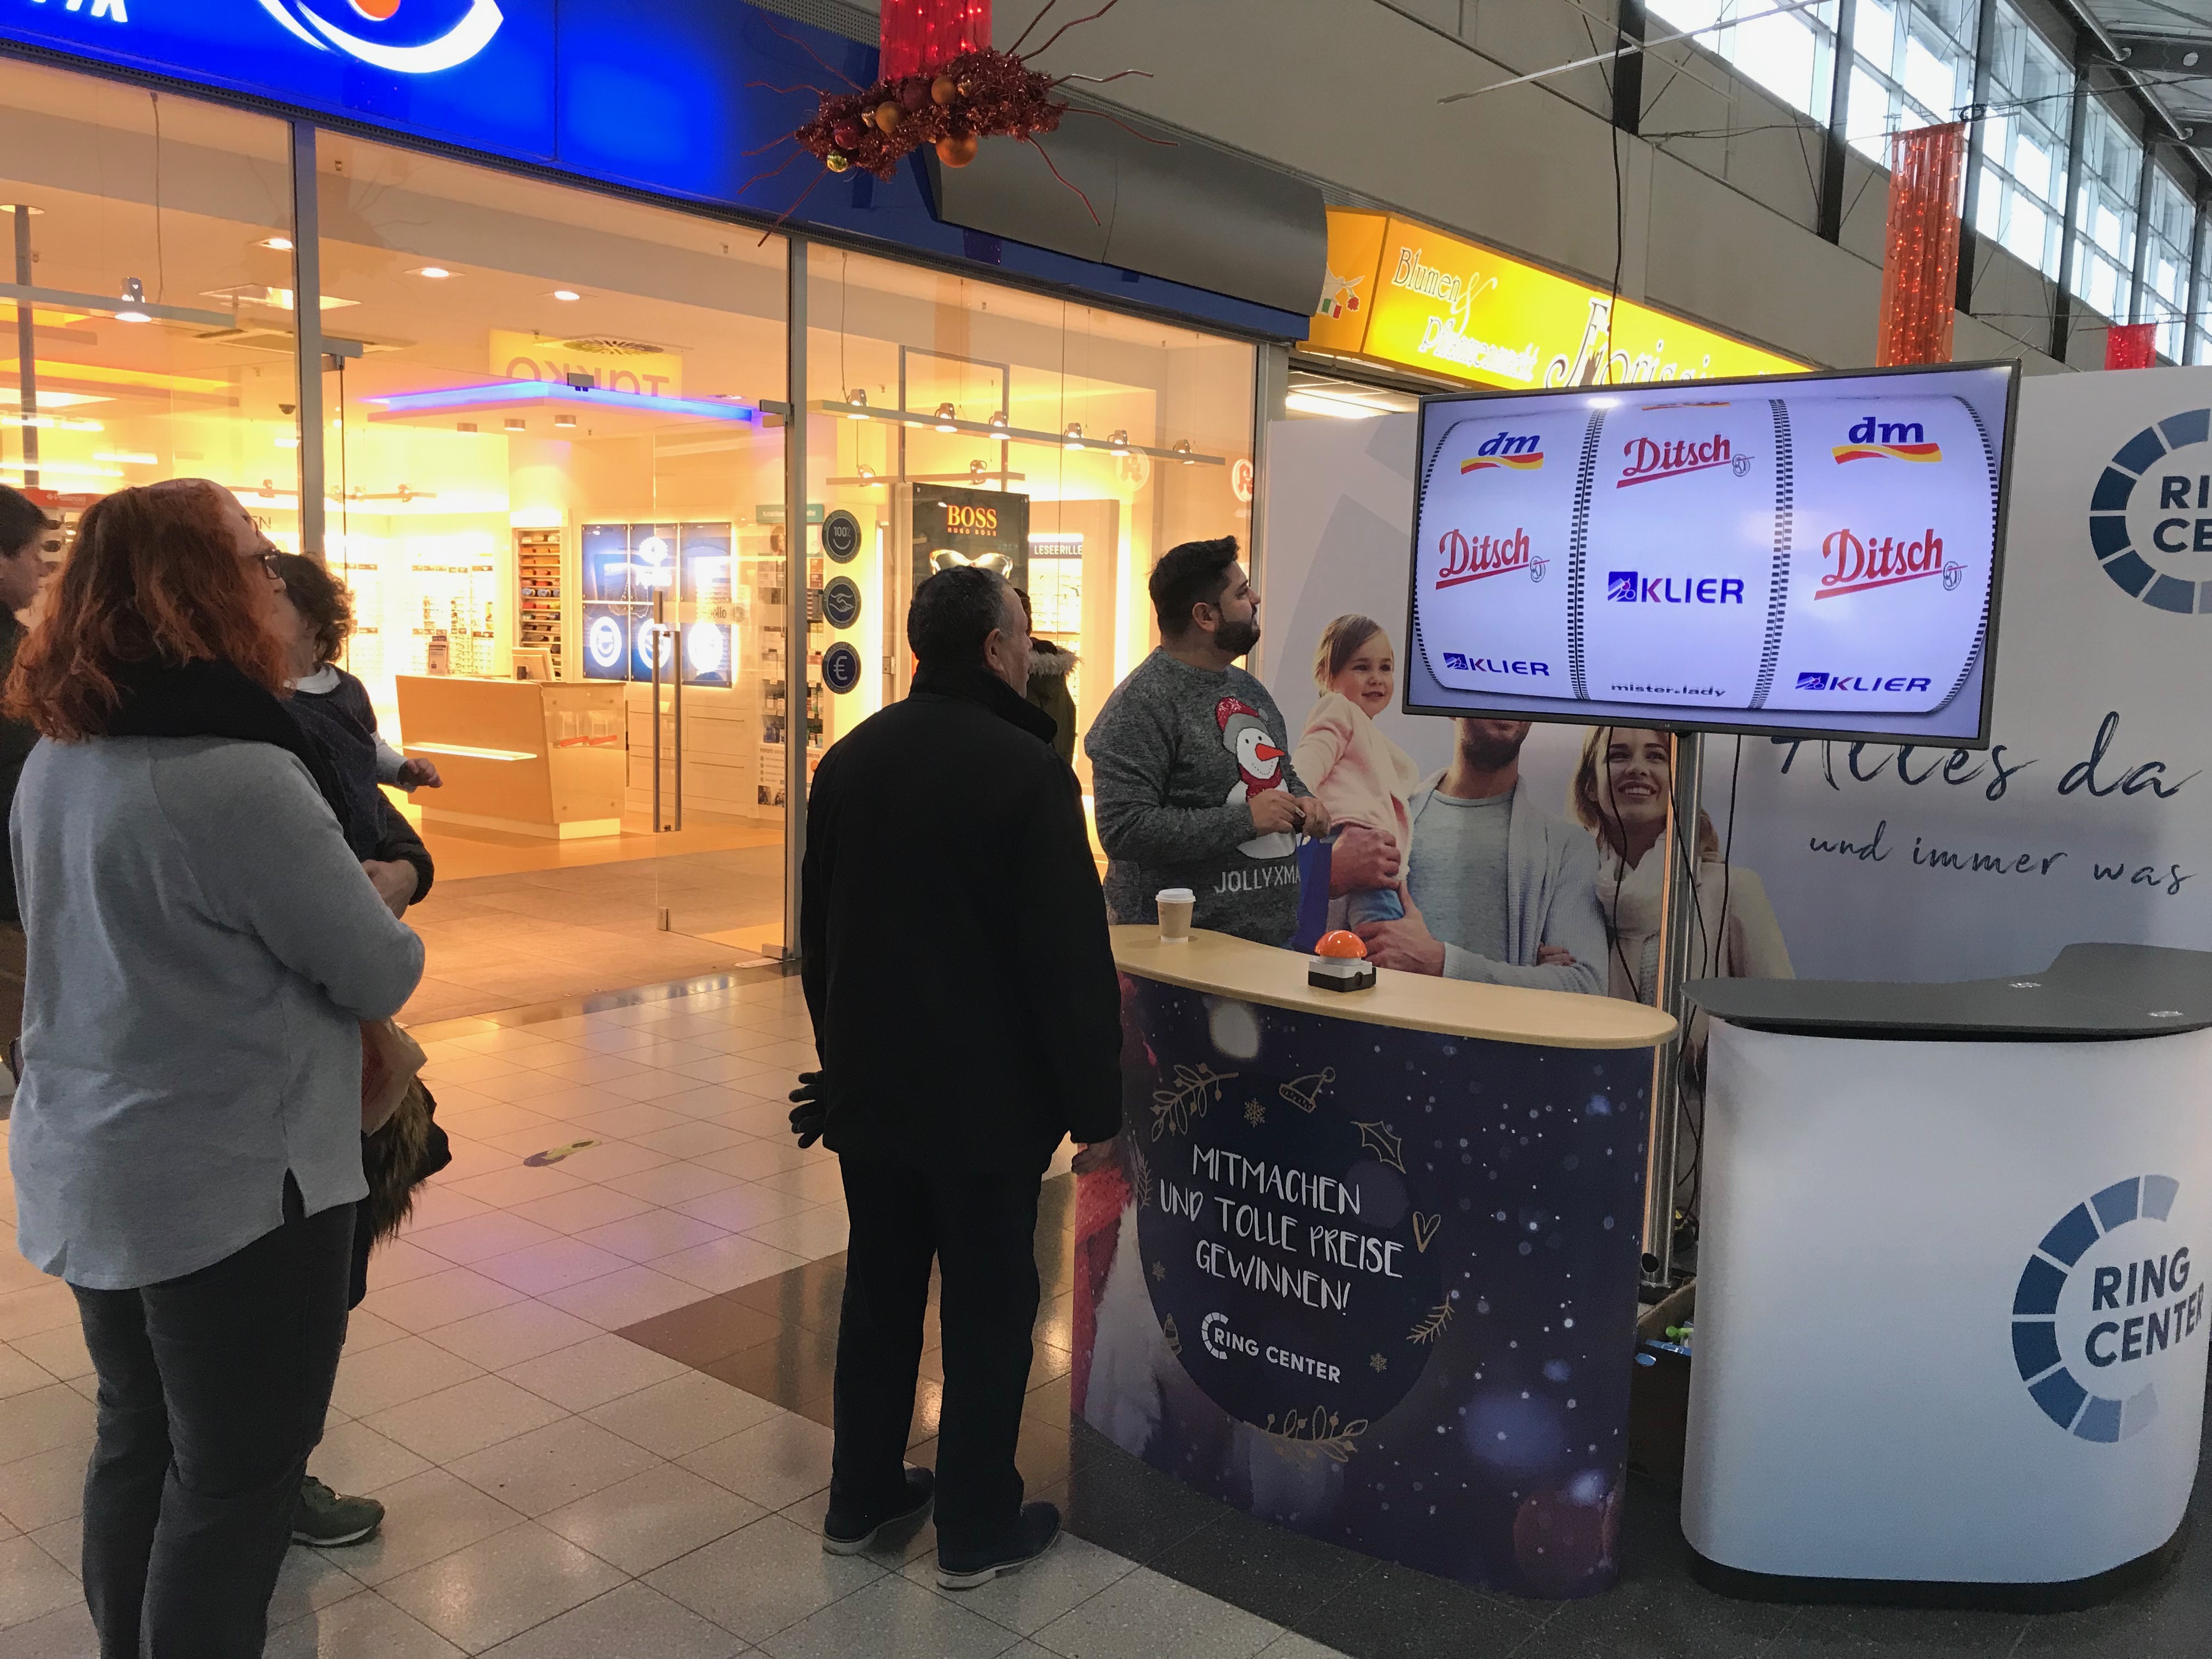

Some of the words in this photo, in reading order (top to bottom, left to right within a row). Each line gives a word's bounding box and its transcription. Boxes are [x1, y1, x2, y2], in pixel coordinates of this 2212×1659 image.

[1392, 247, 1463, 303] Blumen
[1478, 432, 1540, 456] dm
[1622, 435, 1730, 476] Ditsch
[1848, 417, 1924, 443] dm
[833, 526, 851, 537] 100%
[947, 505, 997, 529] BOSS
[1439, 528, 1530, 578] Ditsch
[1821, 529, 1943, 586] Ditsch
[1641, 578, 1745, 604] KLIER
[1469, 658, 1550, 676] KLIER
[1829, 676, 1932, 692] KLIER
[2058, 712, 2201, 798] da
[1810, 821, 1893, 861] und
[1914, 837, 2068, 876] immer
[2094, 862, 2199, 895] was
[1192, 1144, 1361, 1215] MITMACHEN
[1160, 1180, 1204, 1221] UND
[1214, 1197, 1299, 1252] TOLLE
[1310, 1225, 1404, 1278] PREISE
[1196, 1240, 1351, 1316] GEWINNEN!
[2092, 1246, 2190, 1311] RING
[2085, 1282, 2204, 1367] CENTER
[1214, 1327, 1259, 1357] RING
[1266, 1346, 1341, 1384] CENTER
